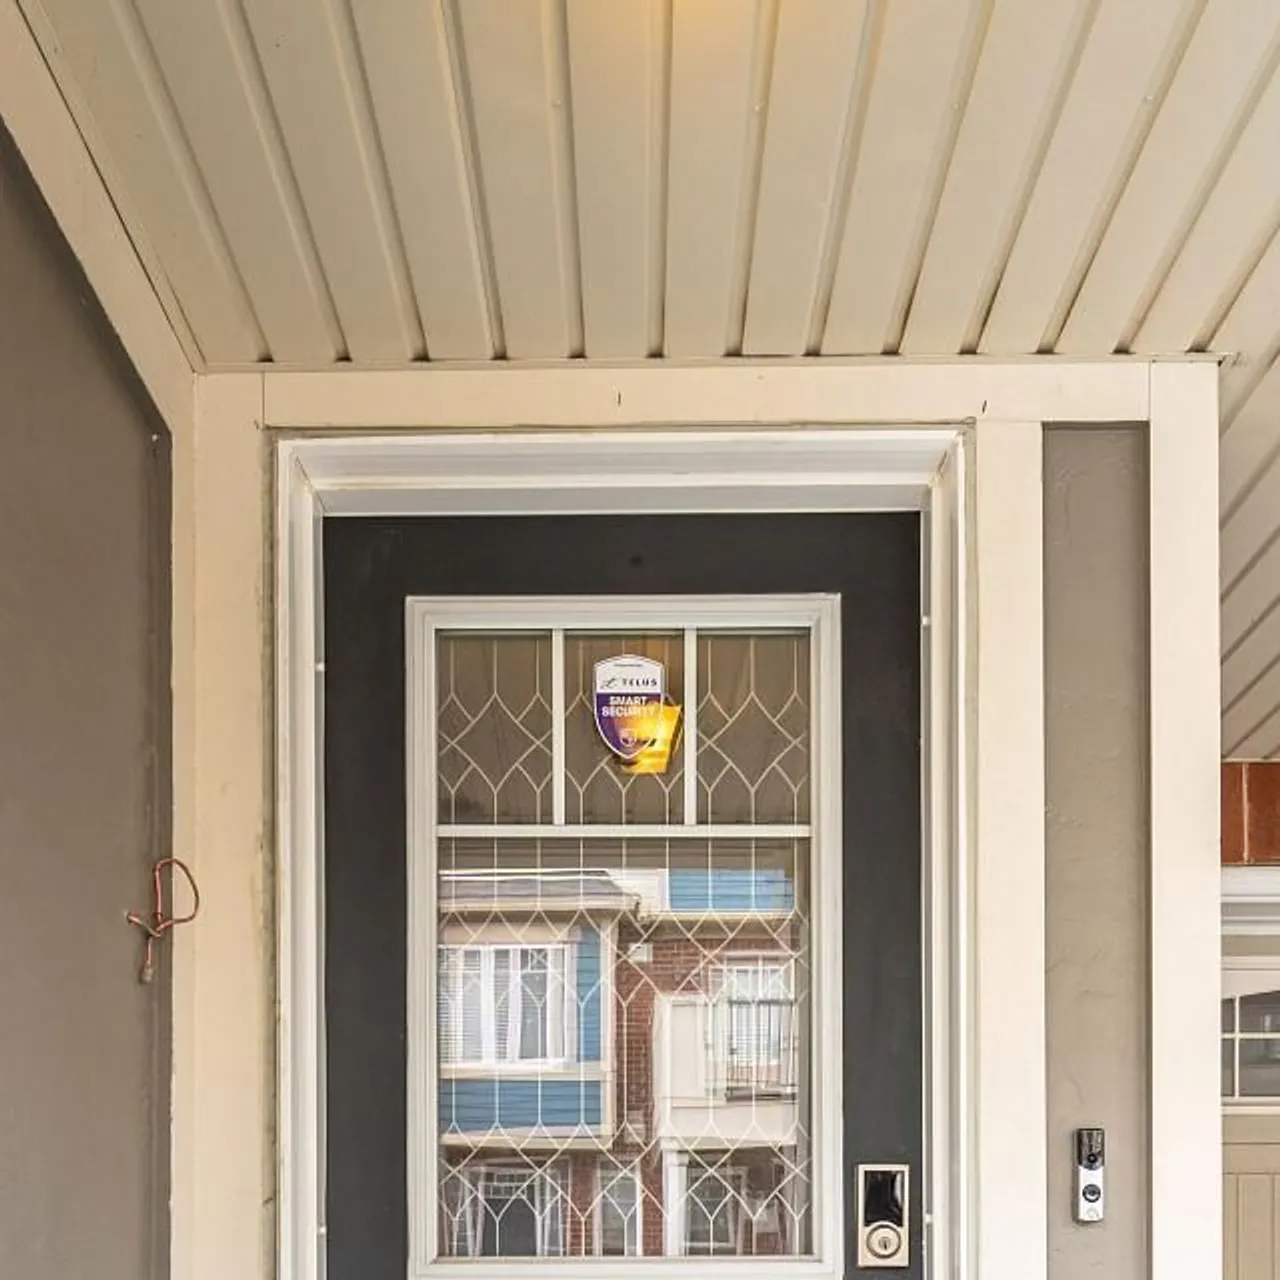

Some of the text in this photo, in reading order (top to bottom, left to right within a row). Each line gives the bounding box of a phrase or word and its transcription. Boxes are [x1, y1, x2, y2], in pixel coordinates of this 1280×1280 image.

[621, 678, 658, 687] TELUS
[609, 695, 648, 705] SMART
[601, 705, 656, 717] SECURITY
